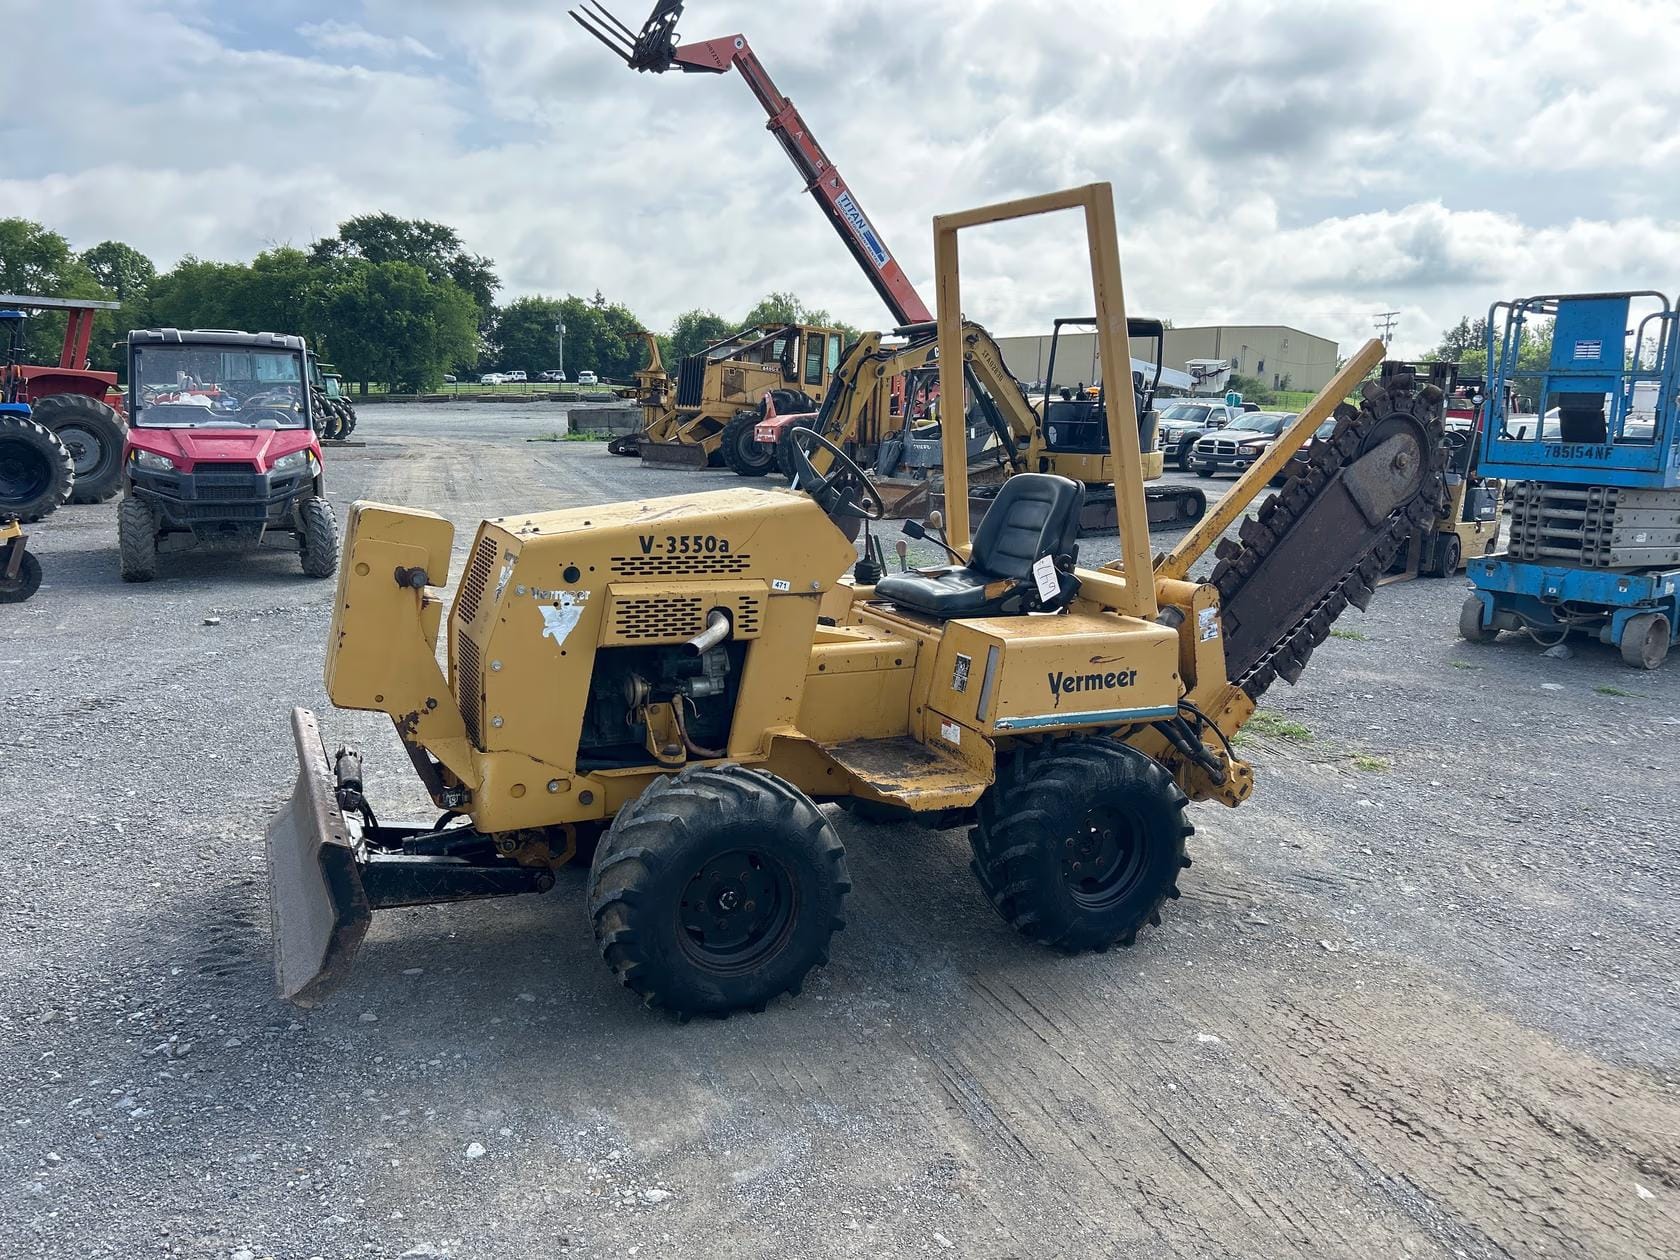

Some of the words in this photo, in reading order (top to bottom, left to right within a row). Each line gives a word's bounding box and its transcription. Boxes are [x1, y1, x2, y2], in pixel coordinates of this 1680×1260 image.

[840, 194, 866, 229] TITAN
[639, 535, 729, 554] V-3550a
[774, 580, 788, 590] 471
[1048, 669, 1138, 695] Vermeer
